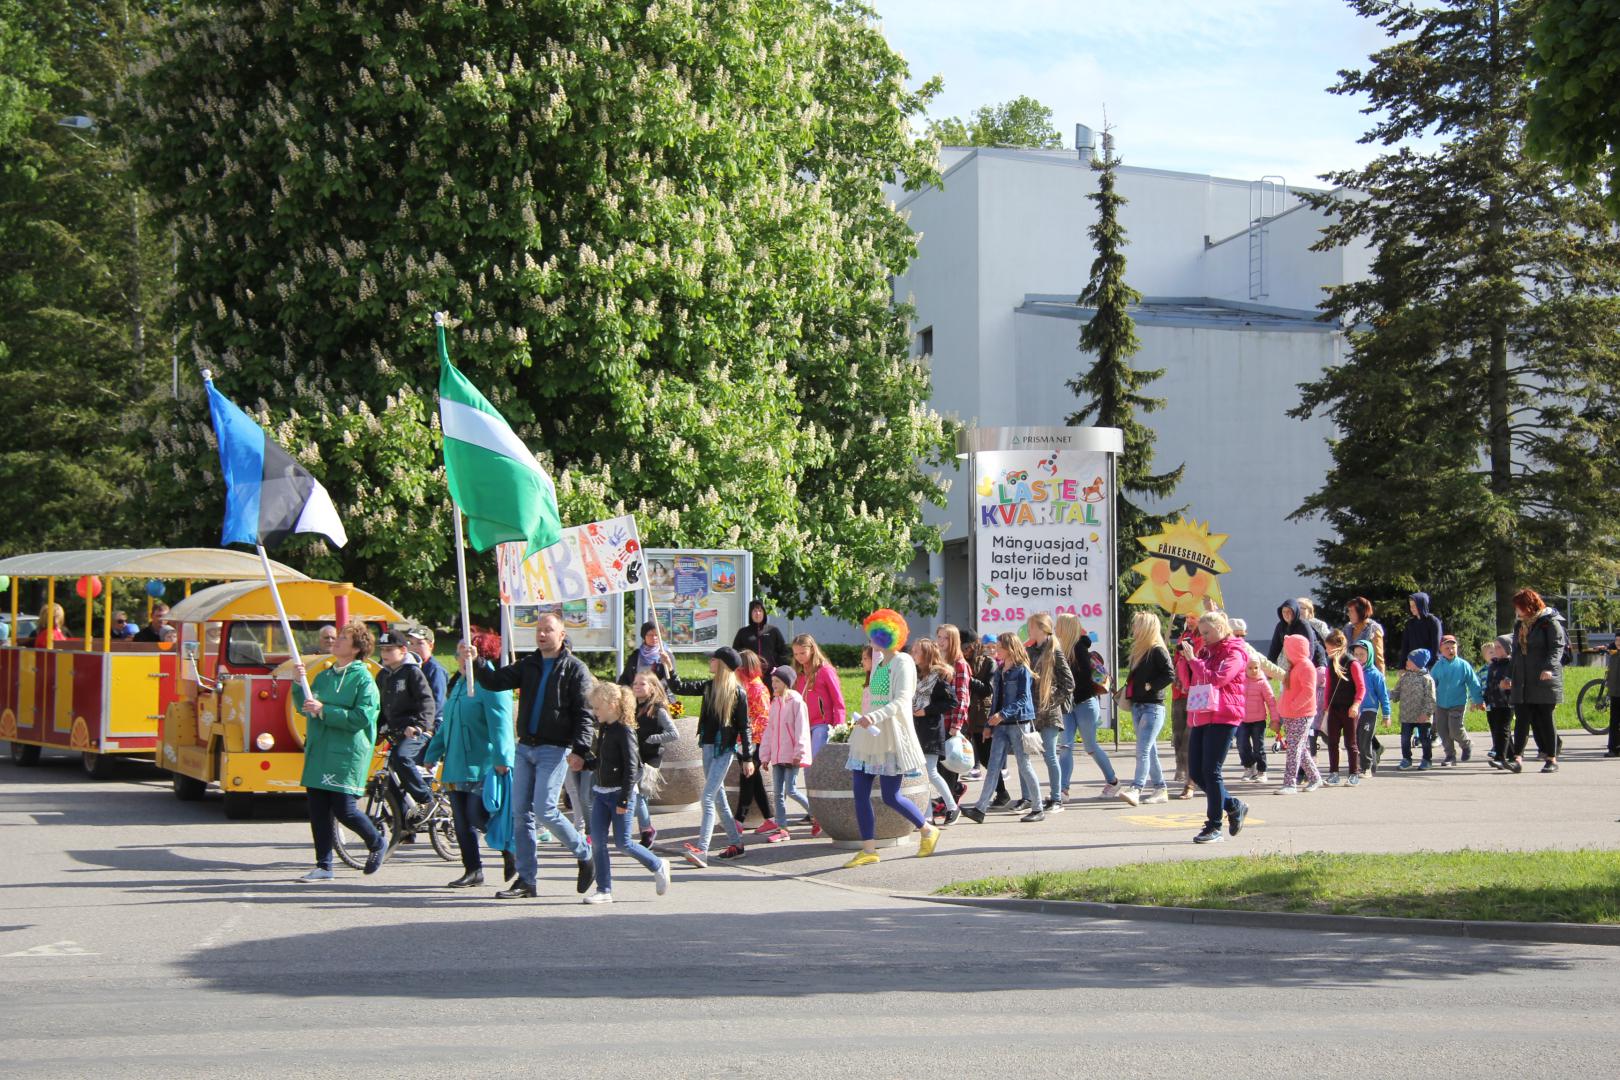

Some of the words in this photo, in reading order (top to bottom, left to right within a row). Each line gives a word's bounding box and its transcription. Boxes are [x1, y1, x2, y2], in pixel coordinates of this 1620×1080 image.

[1023, 435, 1054, 443] PRISMA
[1056, 435, 1072, 443] NET
[998, 478, 1077, 503] LASTE
[981, 501, 1100, 526] KVARTAL
[992, 535, 1090, 552] Mänguasjad,
[991, 551, 1072, 566] lasteriided
[1075, 553, 1088, 568] ja
[1158, 543, 1216, 568] PÄIKESERATAS
[990, 568, 1028, 584] palju
[1032, 567, 1089, 582] lõbusat
[1005, 582, 1073, 598] tegemist
[980, 607, 1026, 622] 29.05
